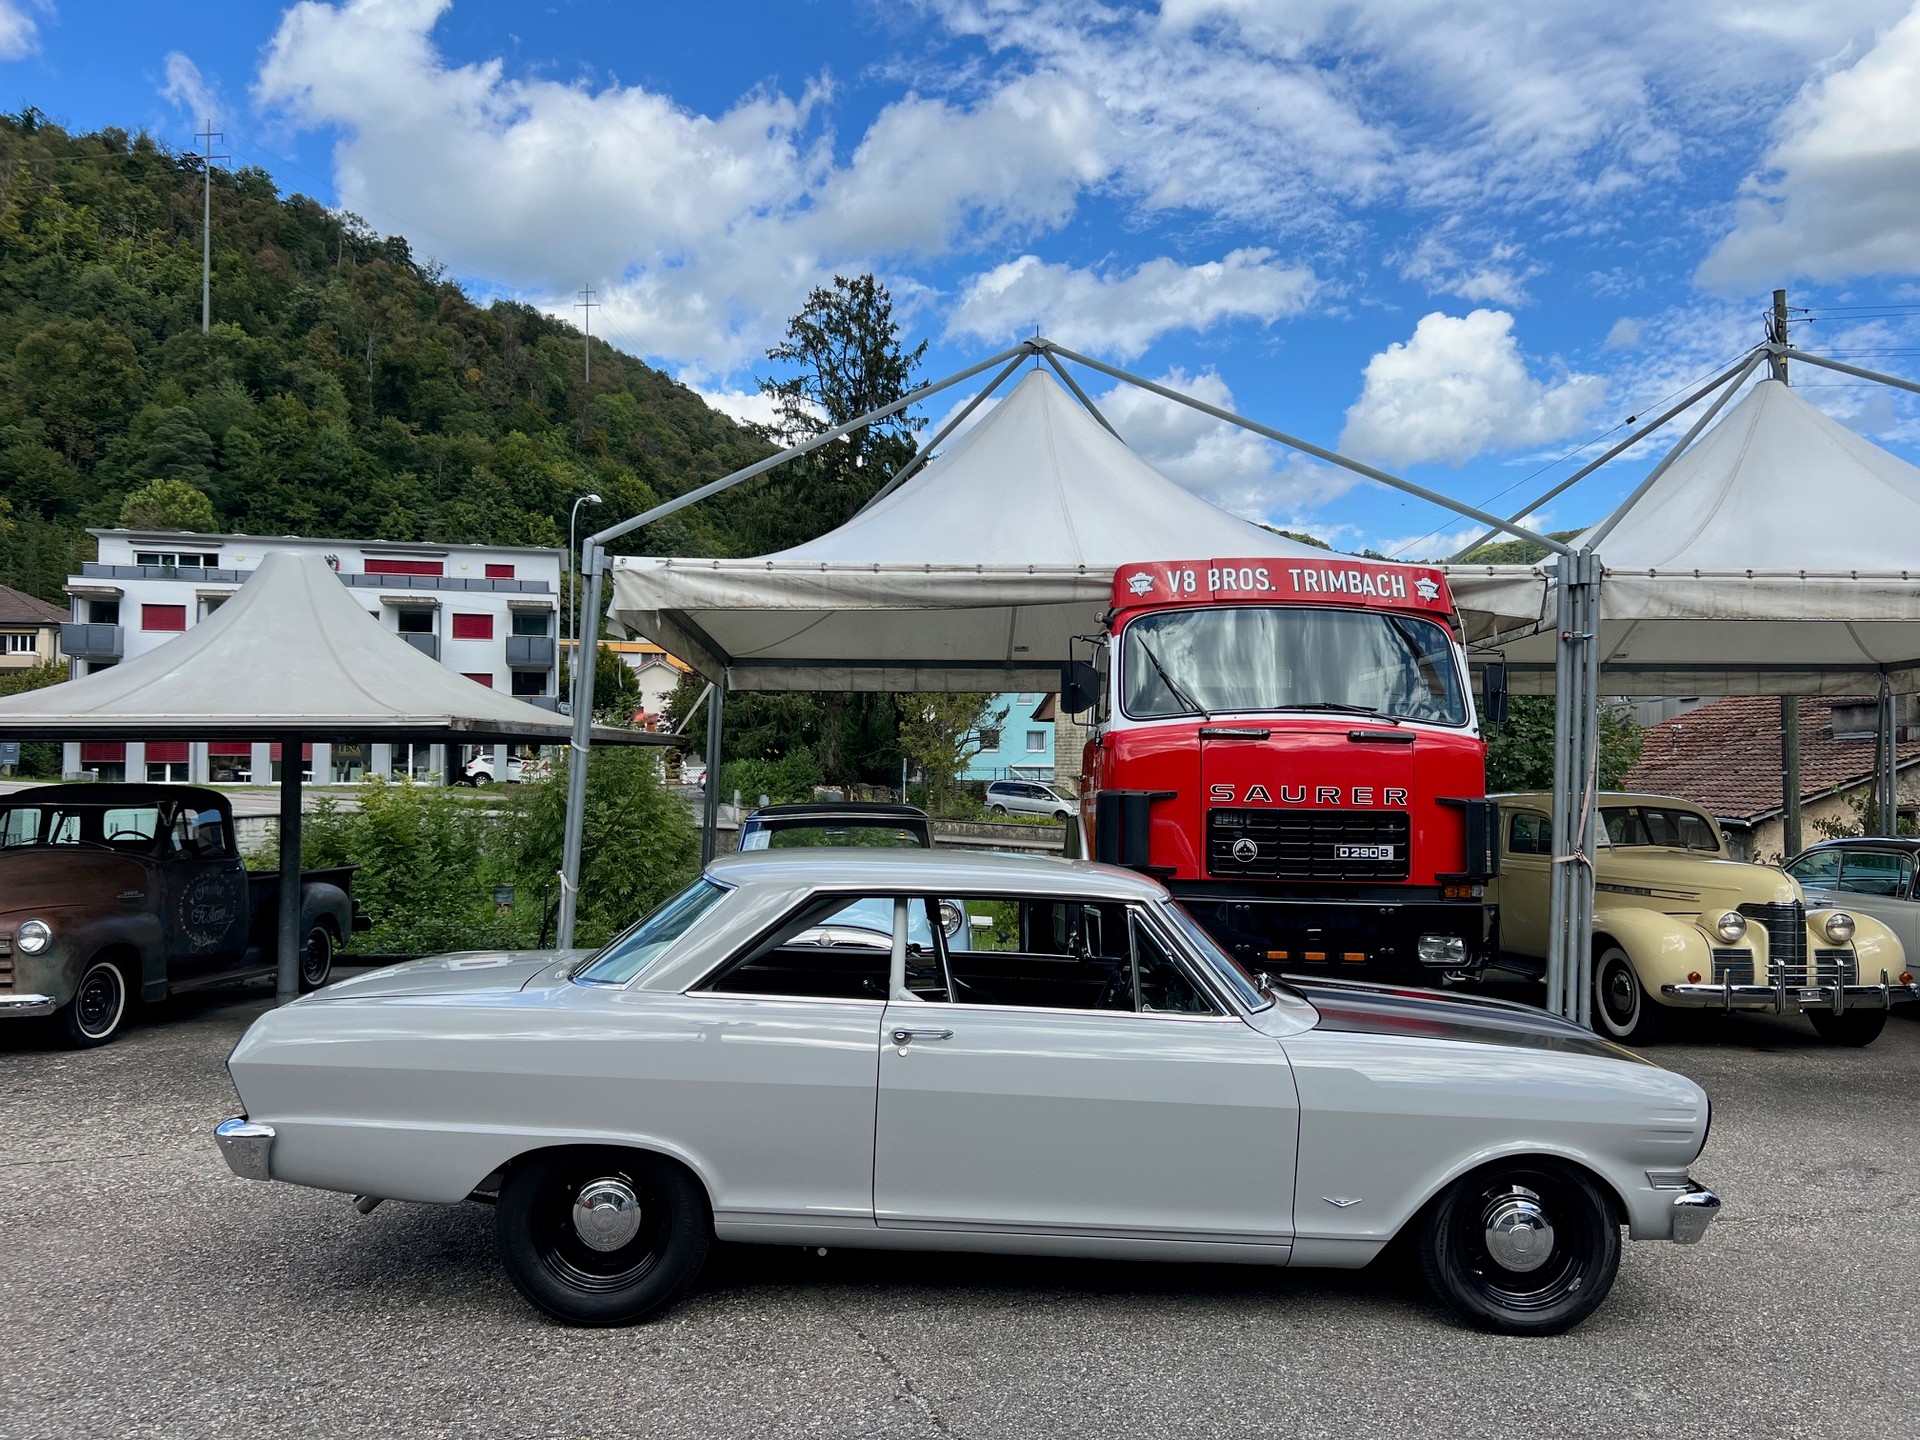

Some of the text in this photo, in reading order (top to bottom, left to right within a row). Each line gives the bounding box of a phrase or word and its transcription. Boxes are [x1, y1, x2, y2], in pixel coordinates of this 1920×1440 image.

[1166, 570, 1196, 593] V8
[1207, 568, 1277, 592] BROS.
[1288, 569, 1407, 598] TRIMBACH
[1209, 784, 1409, 806] SAURER
